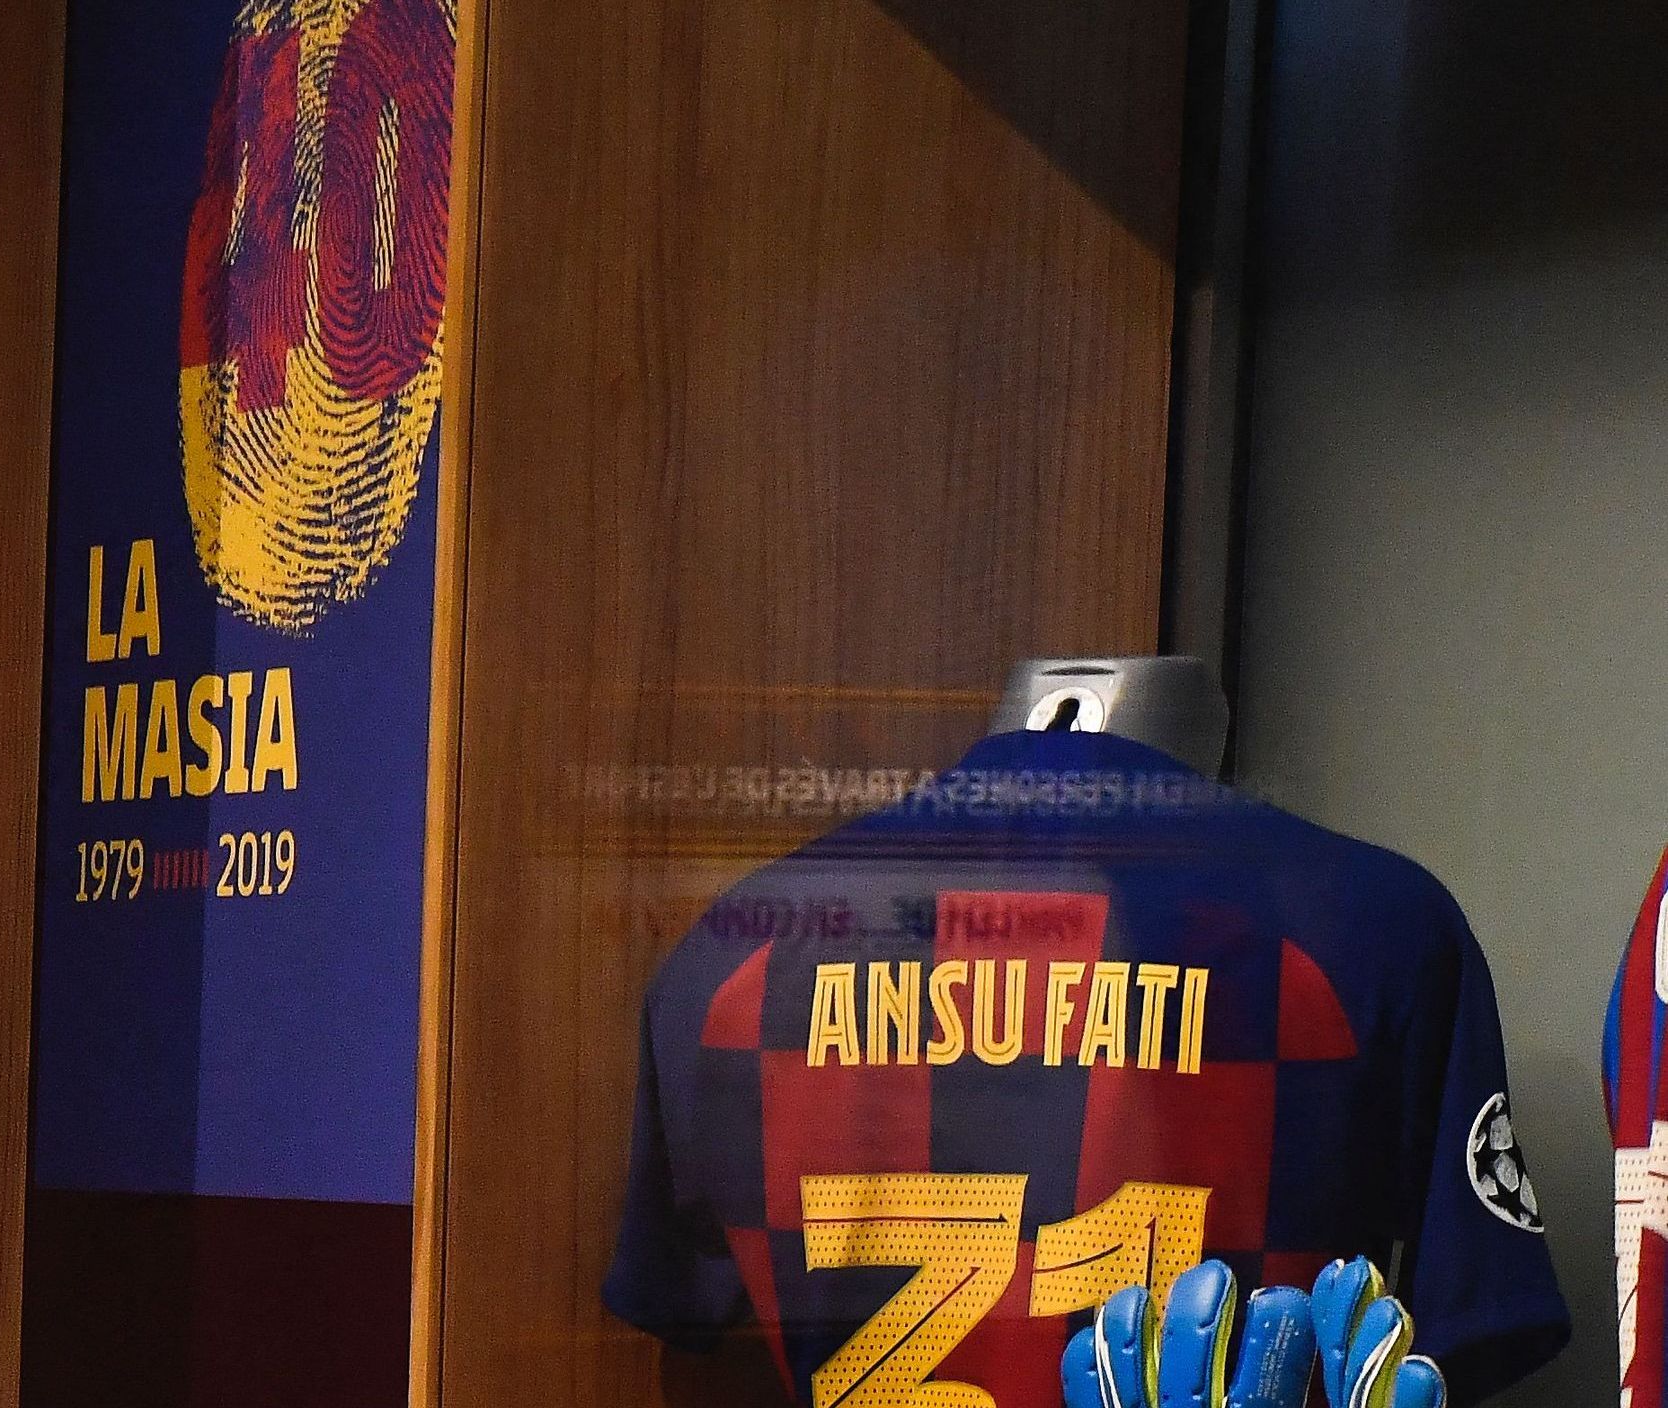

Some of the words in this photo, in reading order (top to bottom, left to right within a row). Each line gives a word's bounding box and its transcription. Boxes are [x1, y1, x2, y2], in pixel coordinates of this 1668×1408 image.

[85, 538, 162, 663] LA
[81, 666, 299, 804] MASIA
[75, 838, 145, 903] 1979
[216, 830, 297, 898] 2019
[806, 958, 1027, 1069] ANSU
[1041, 960, 1210, 1075] FATI
